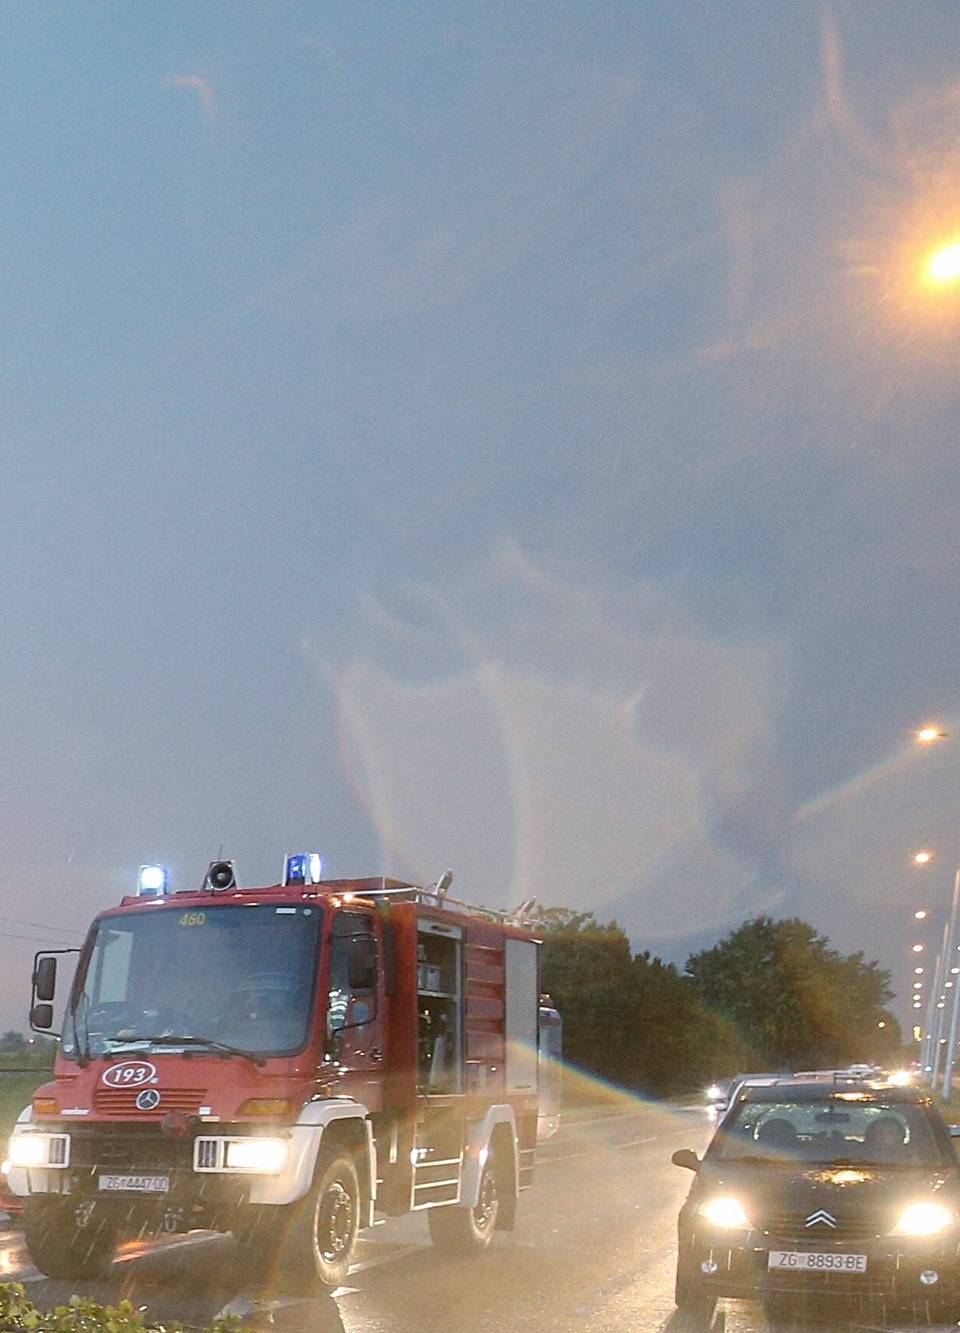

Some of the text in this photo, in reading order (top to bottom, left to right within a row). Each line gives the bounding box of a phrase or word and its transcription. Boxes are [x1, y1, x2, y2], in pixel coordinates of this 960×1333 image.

[179, 912, 205, 927] 460
[114, 1067, 146, 1083] 193
[779, 1253, 864, 1269] ZG 8893-BE
